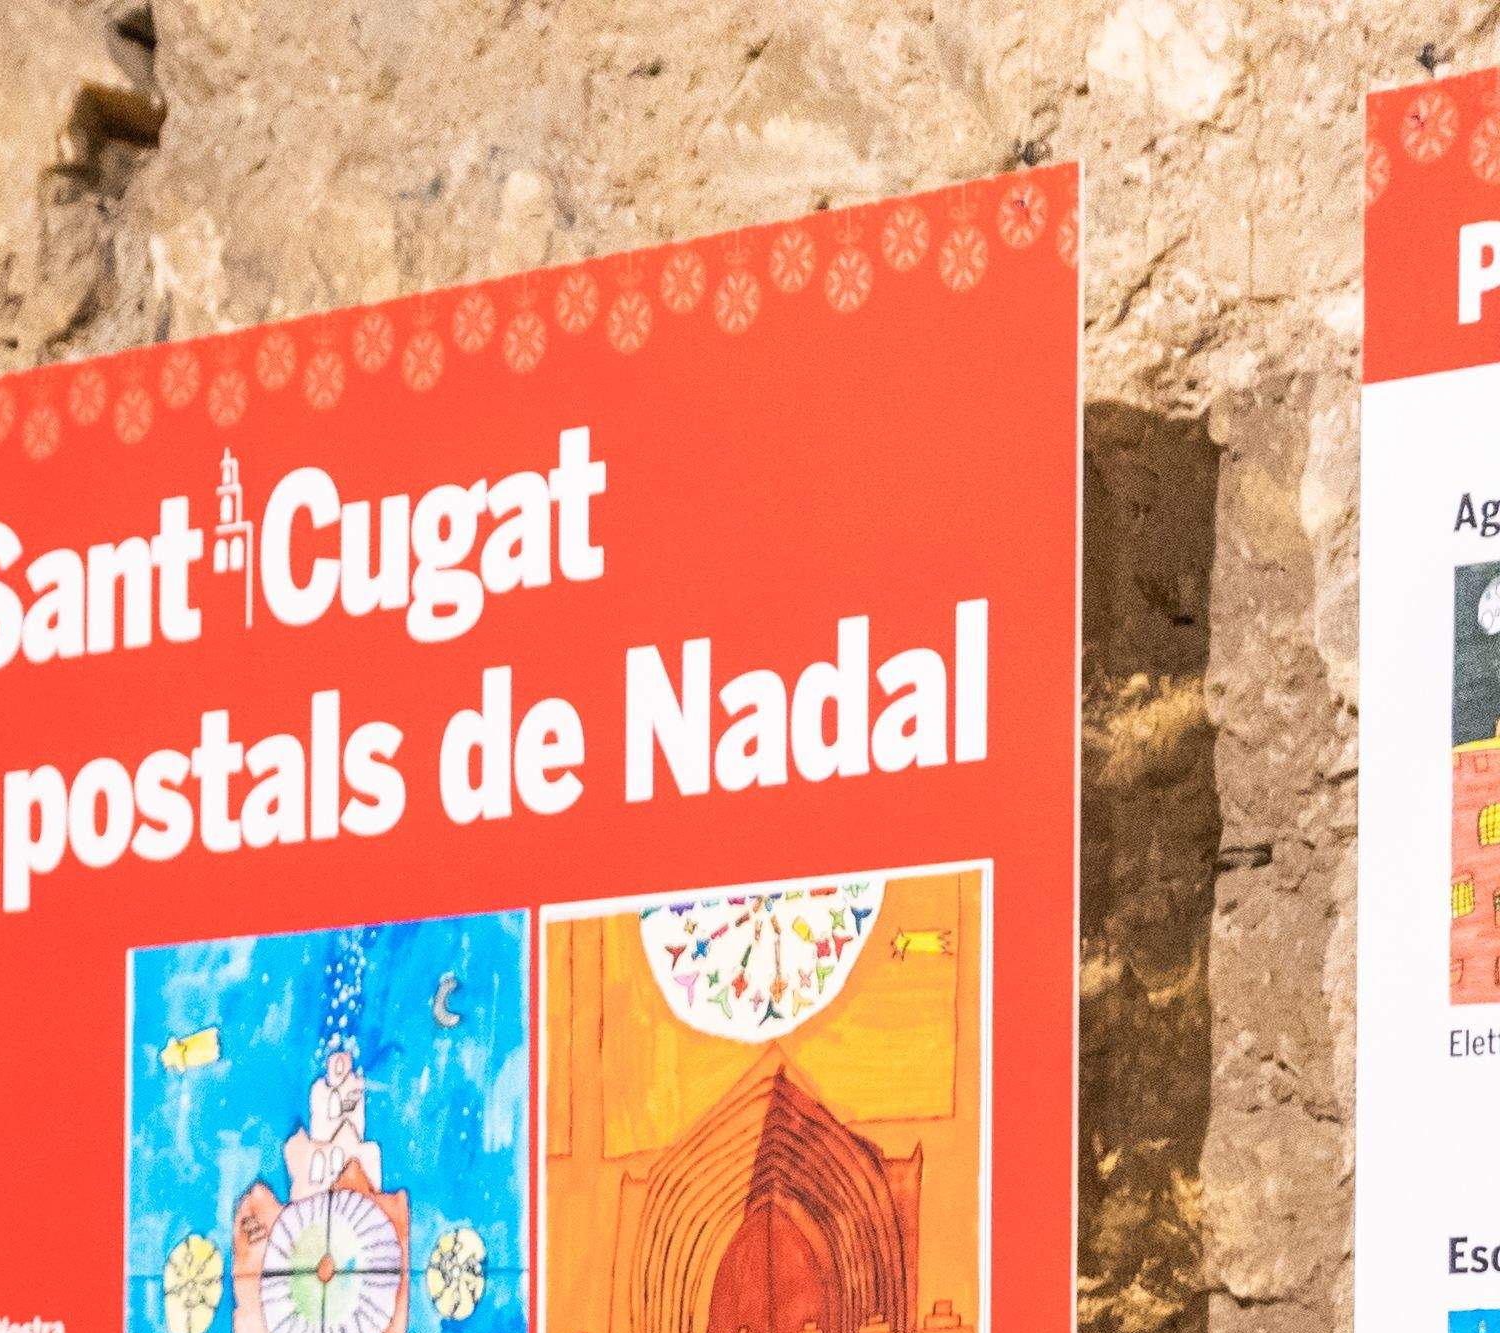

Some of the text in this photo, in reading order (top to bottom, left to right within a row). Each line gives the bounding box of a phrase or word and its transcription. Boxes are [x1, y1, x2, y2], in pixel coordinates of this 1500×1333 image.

[261, 427, 606, 641] Cugat
[3, 692, 405, 911] postals
[440, 666, 583, 824] de
[625, 599, 990, 803] Nadal
